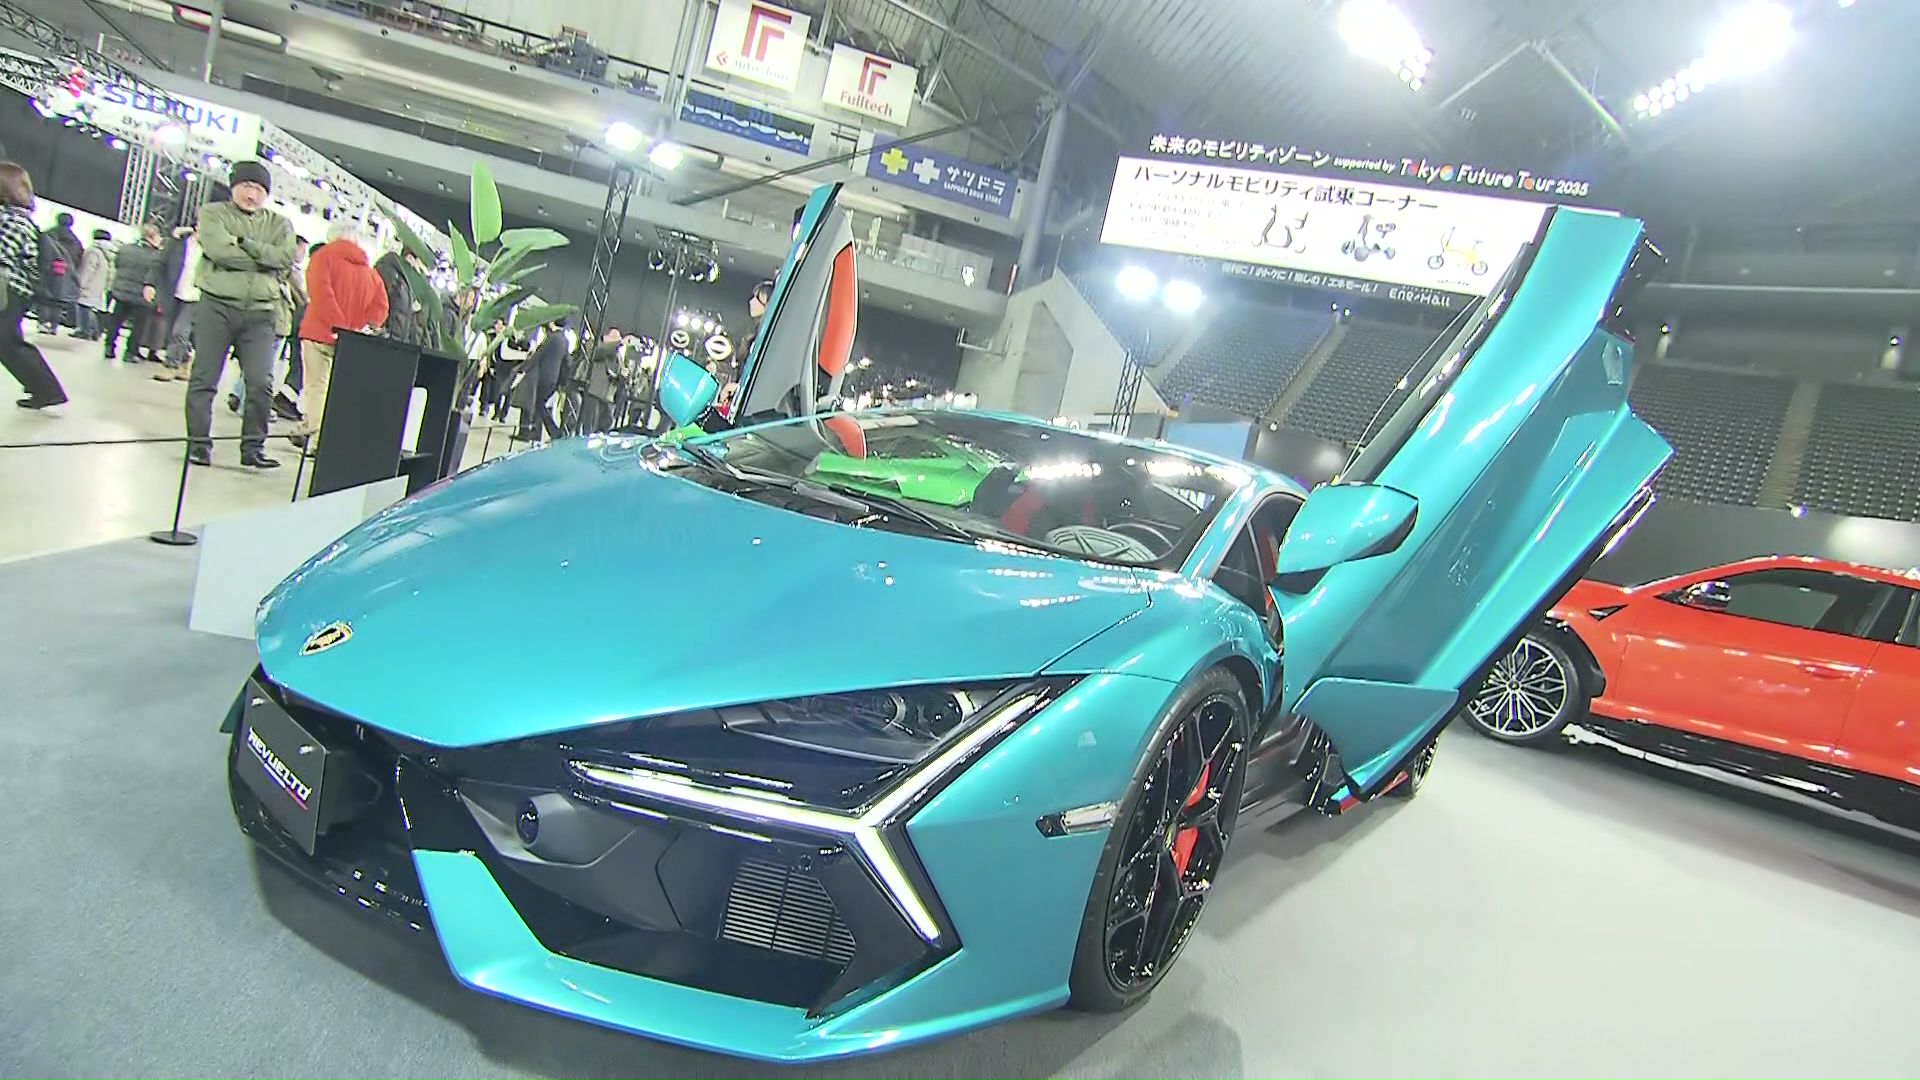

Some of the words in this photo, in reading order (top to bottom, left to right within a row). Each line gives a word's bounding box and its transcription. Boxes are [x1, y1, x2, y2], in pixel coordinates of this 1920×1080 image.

[840, 90, 893, 118] Fulltech
[947, 165, 1007, 196] サツドラ
[1149, 133, 1330, 169] 未来のモビリティゾーン
[1333, 156, 1382, 172] supported
[1382, 159, 1396, 174] by
[1400, 158, 1454, 185] Tokyo
[1457, 164, 1515, 189] Future
[1517, 170, 1555, 193] Tour
[1556, 181, 1590, 197] 2035
[247, 726, 313, 801] REVUELTO
